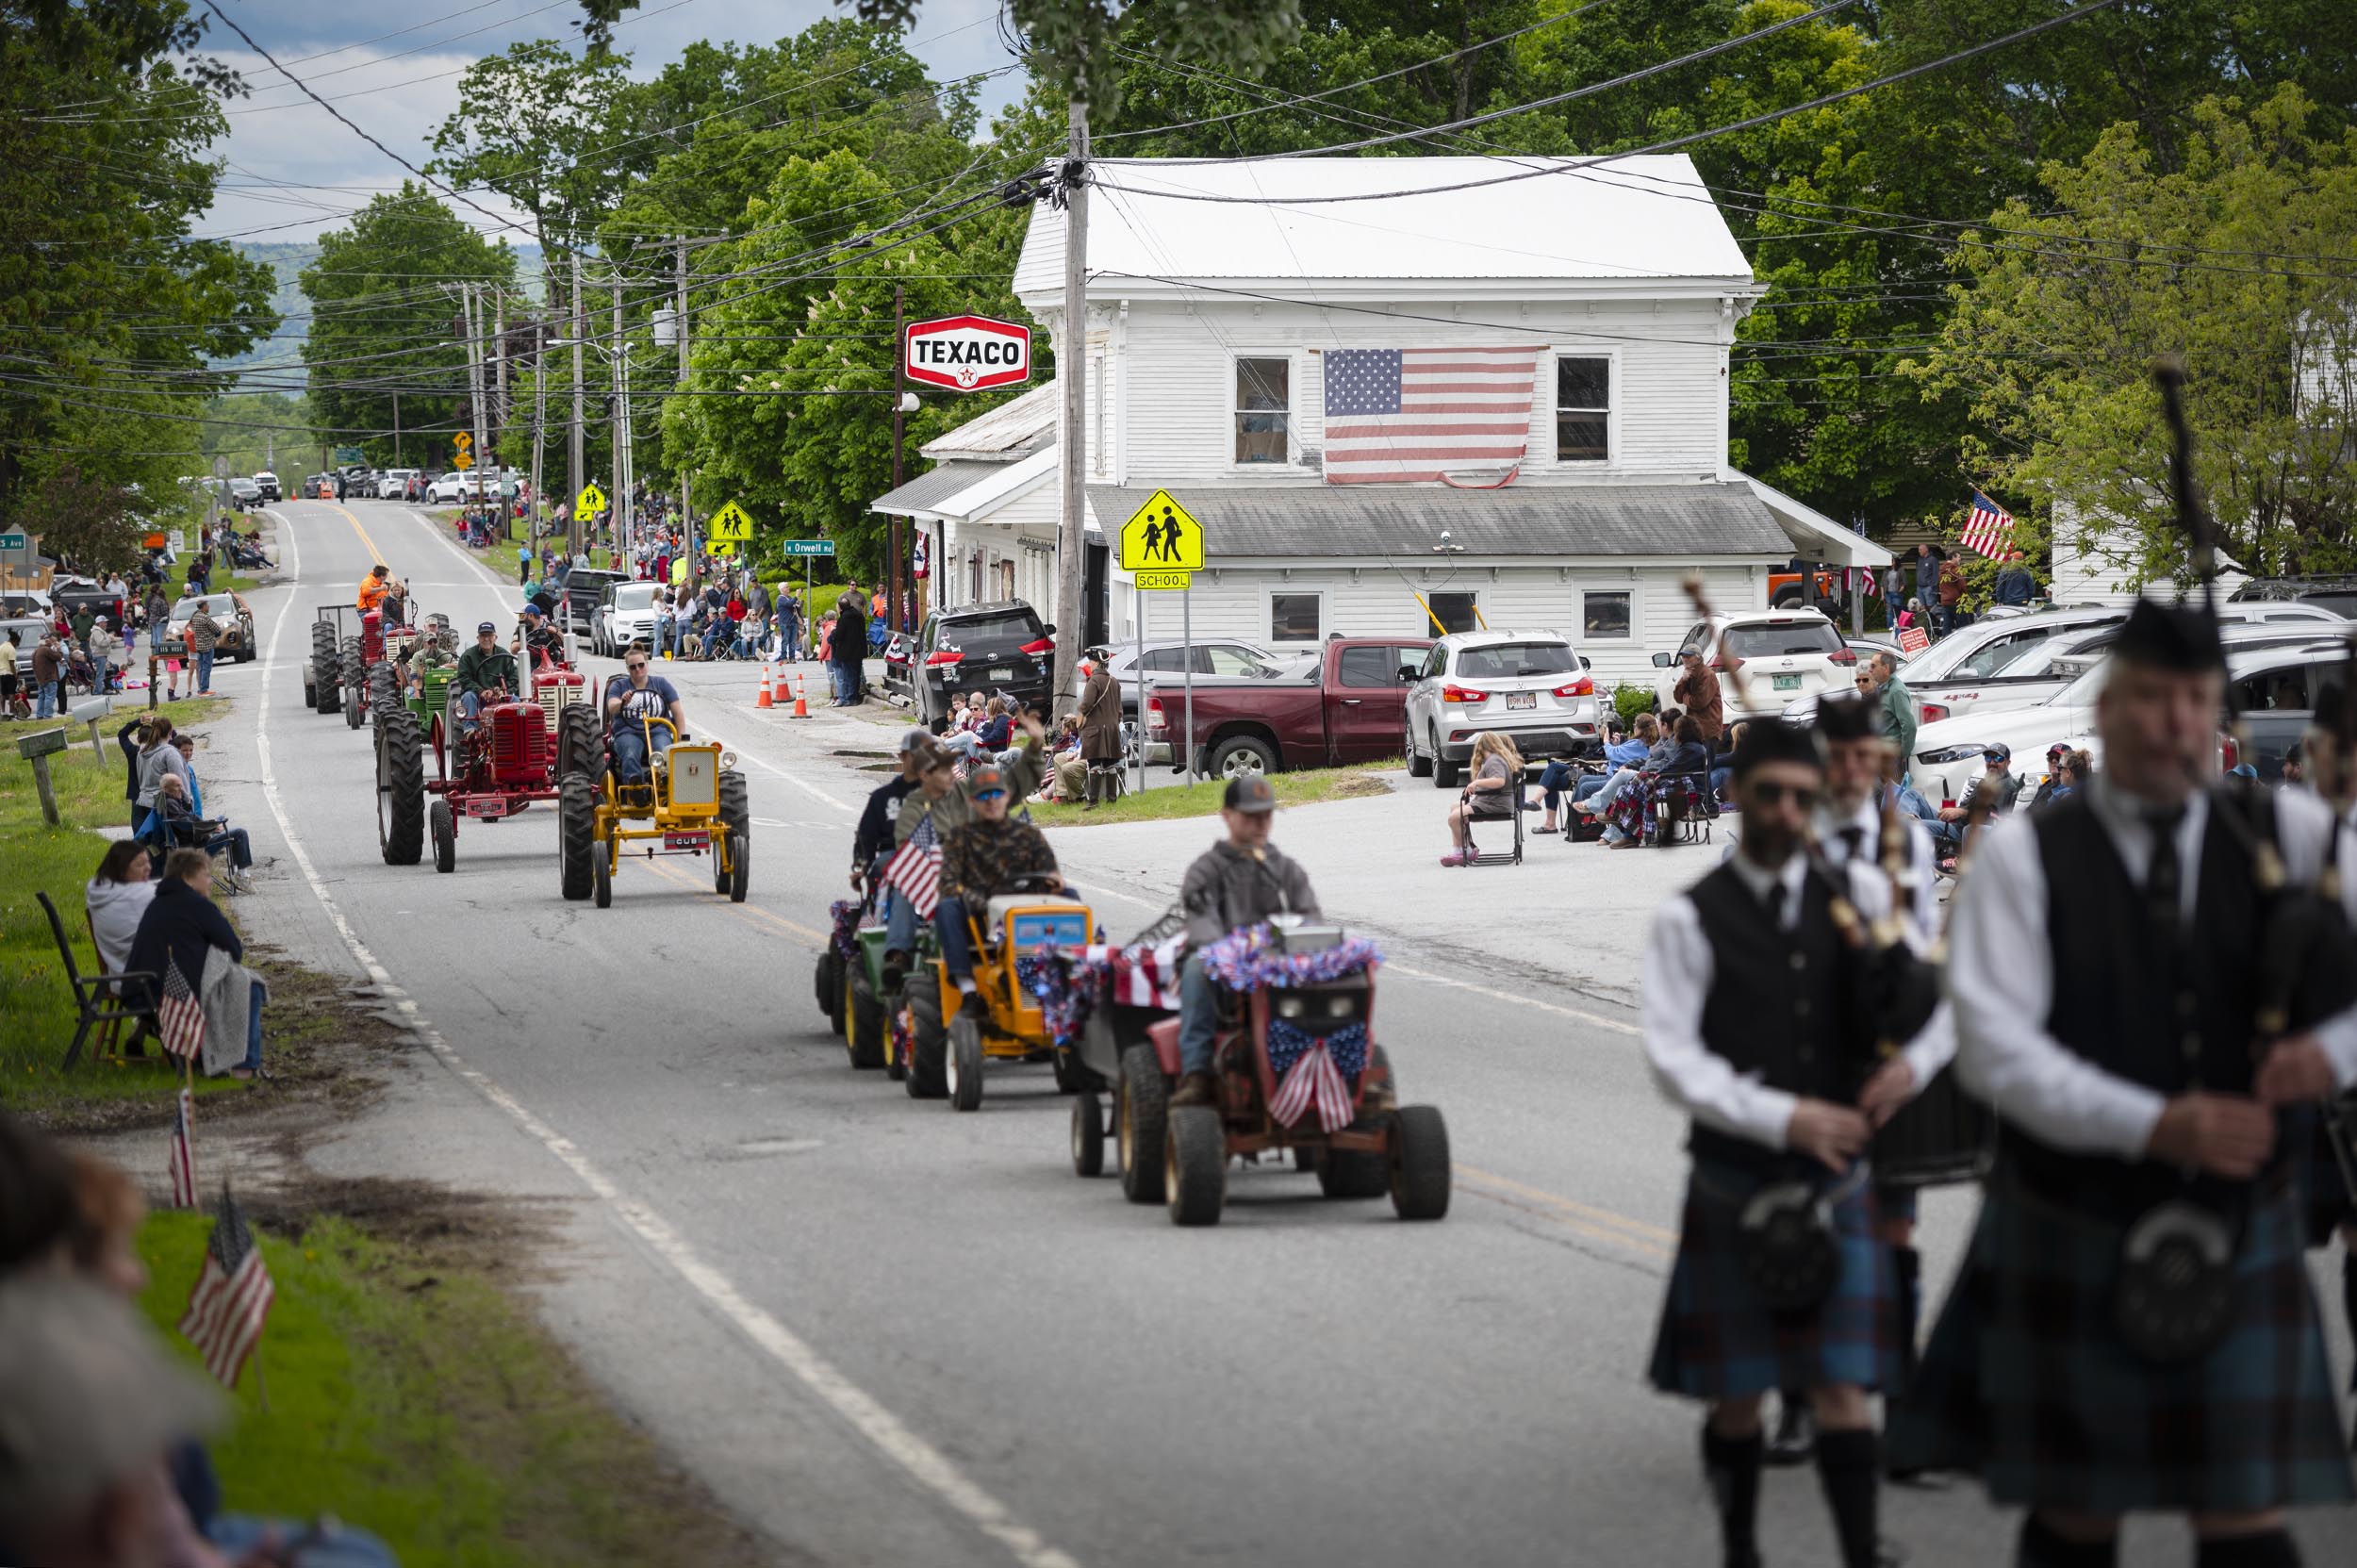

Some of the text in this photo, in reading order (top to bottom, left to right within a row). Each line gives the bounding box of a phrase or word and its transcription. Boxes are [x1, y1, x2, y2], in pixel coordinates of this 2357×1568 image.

[915, 340, 1019, 365] TEXACO
[795, 542, 821, 553] Orwell
[1139, 575, 1187, 586] SCHOOL
